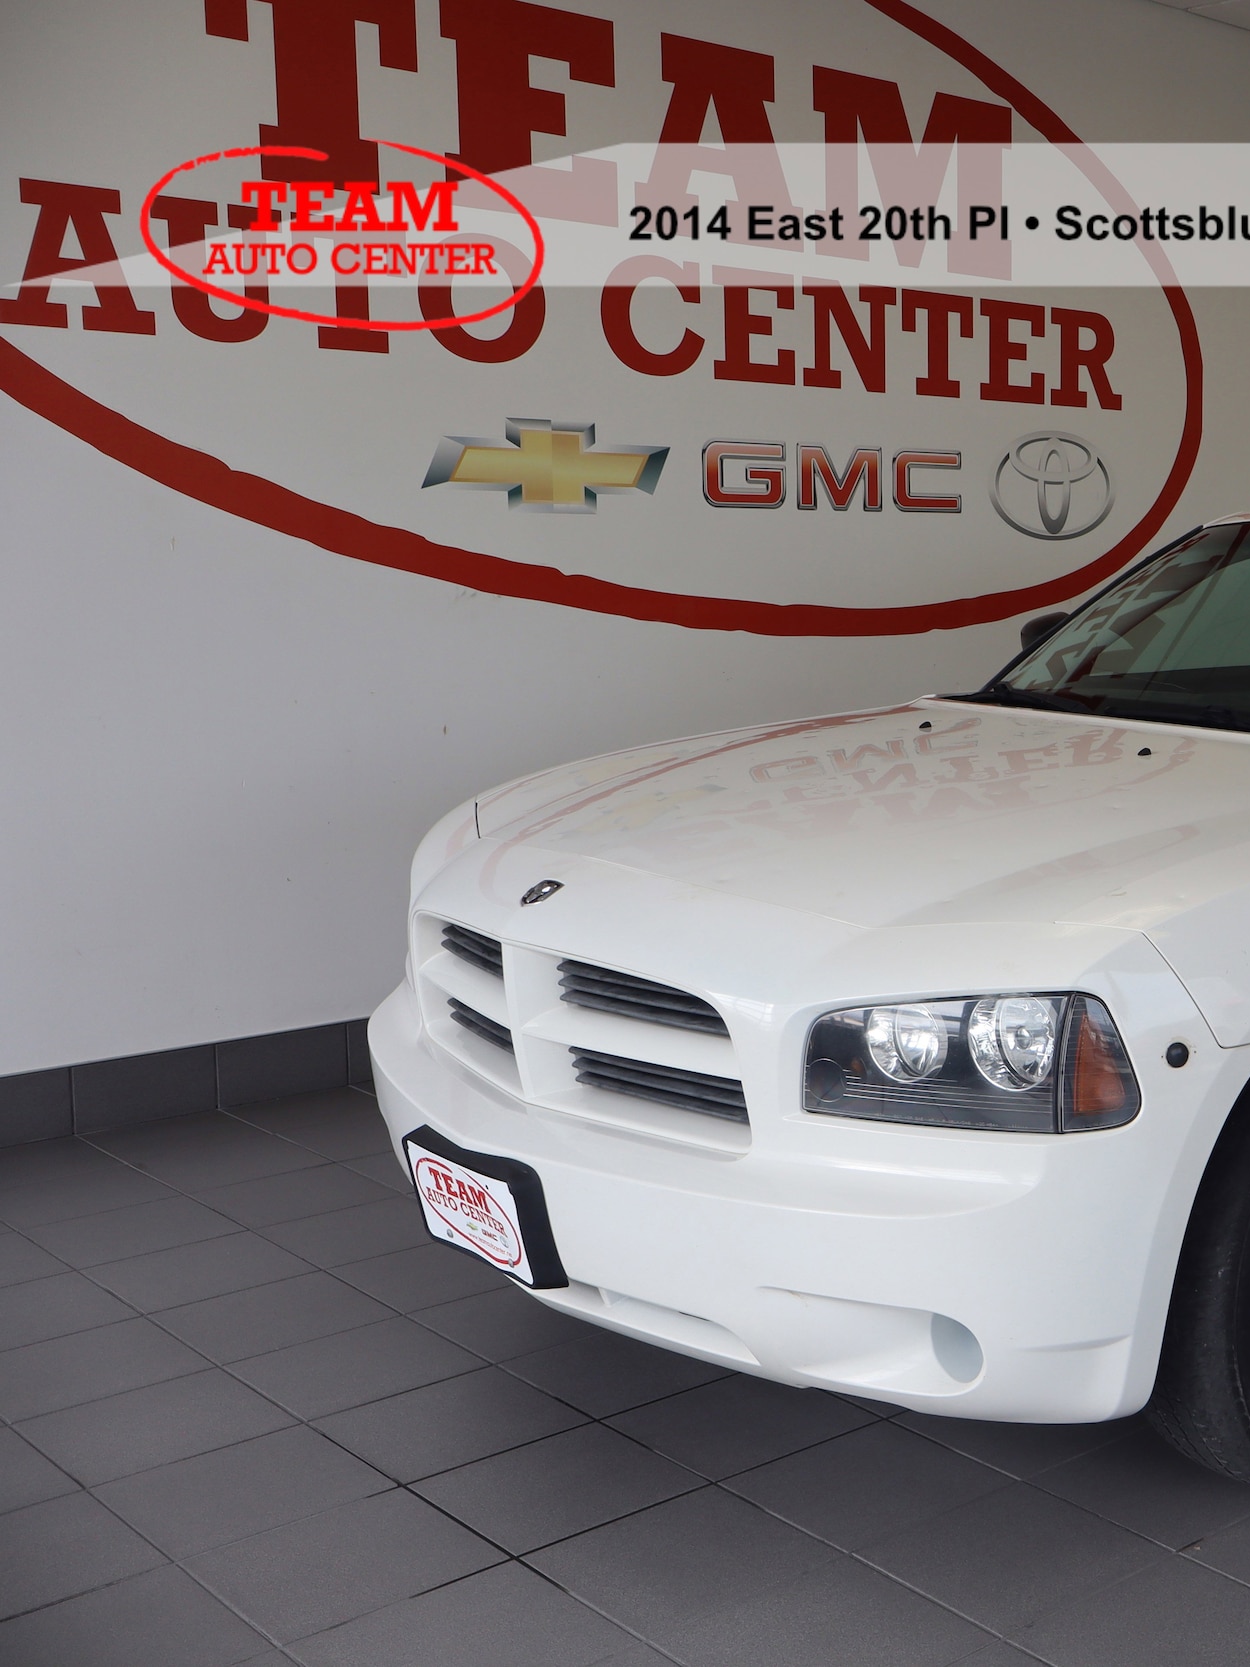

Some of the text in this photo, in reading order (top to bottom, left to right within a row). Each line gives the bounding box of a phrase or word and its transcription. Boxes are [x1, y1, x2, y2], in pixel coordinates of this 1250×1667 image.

[600, 253, 1123, 411] CENTER
[701, 437, 962, 513] GMC
[425, 1186, 508, 1238] AUTO CENTER
[428, 1166, 492, 1215] TEAM
[481, 1229, 499, 1242] GMC
